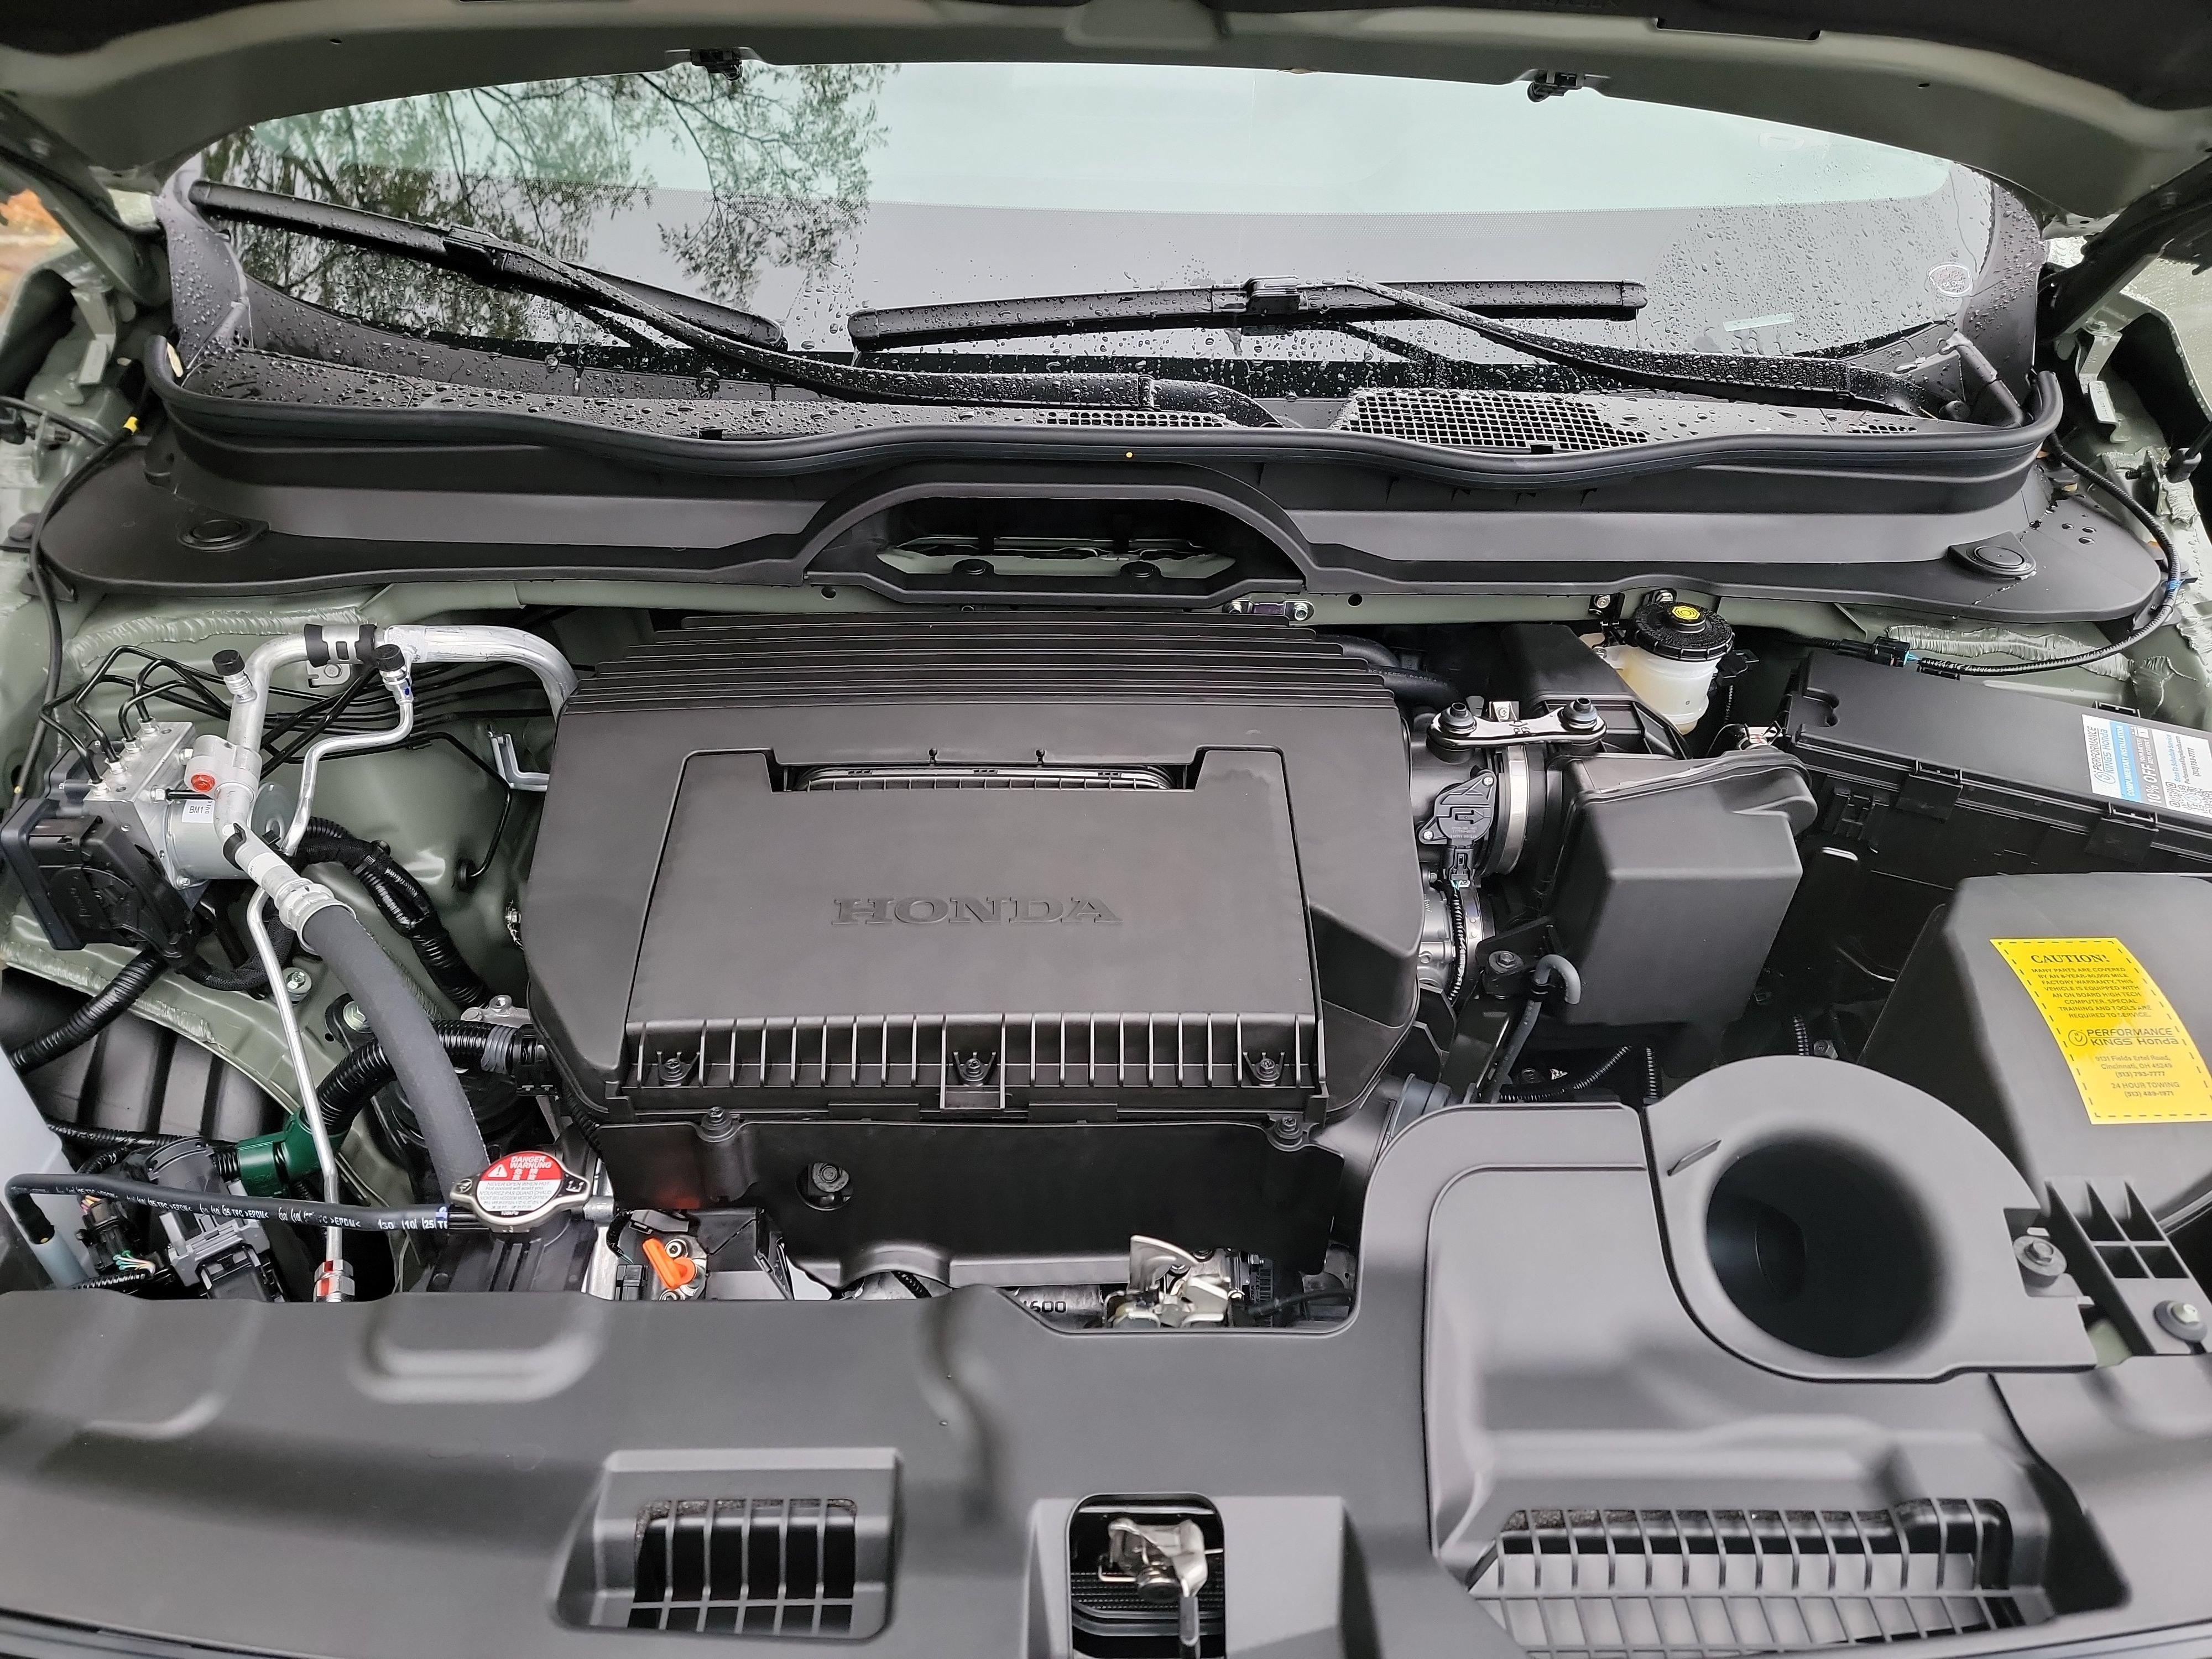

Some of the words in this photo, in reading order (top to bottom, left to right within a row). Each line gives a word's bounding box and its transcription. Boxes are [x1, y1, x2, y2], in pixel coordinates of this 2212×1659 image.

[2087, 726, 2102, 771] PERFORMANCE
[2100, 729, 2110, 750] Honda
[2116, 725, 2128, 756] INSTALLATION
[2103, 752, 2114, 774] KINGS
[2121, 756, 2134, 796] COMPLIMENTARY
[2142, 764, 2157, 784] OFF
[2145, 784, 2162, 804] 10%
[189, 806, 204, 814] BM1
[831, 896, 1124, 925] HONDA
[2031, 954, 2110, 963] CAUTION!
[2086, 1028, 2173, 1036] PERFORMANCE
[231, 1209, 244, 1217] TPC
